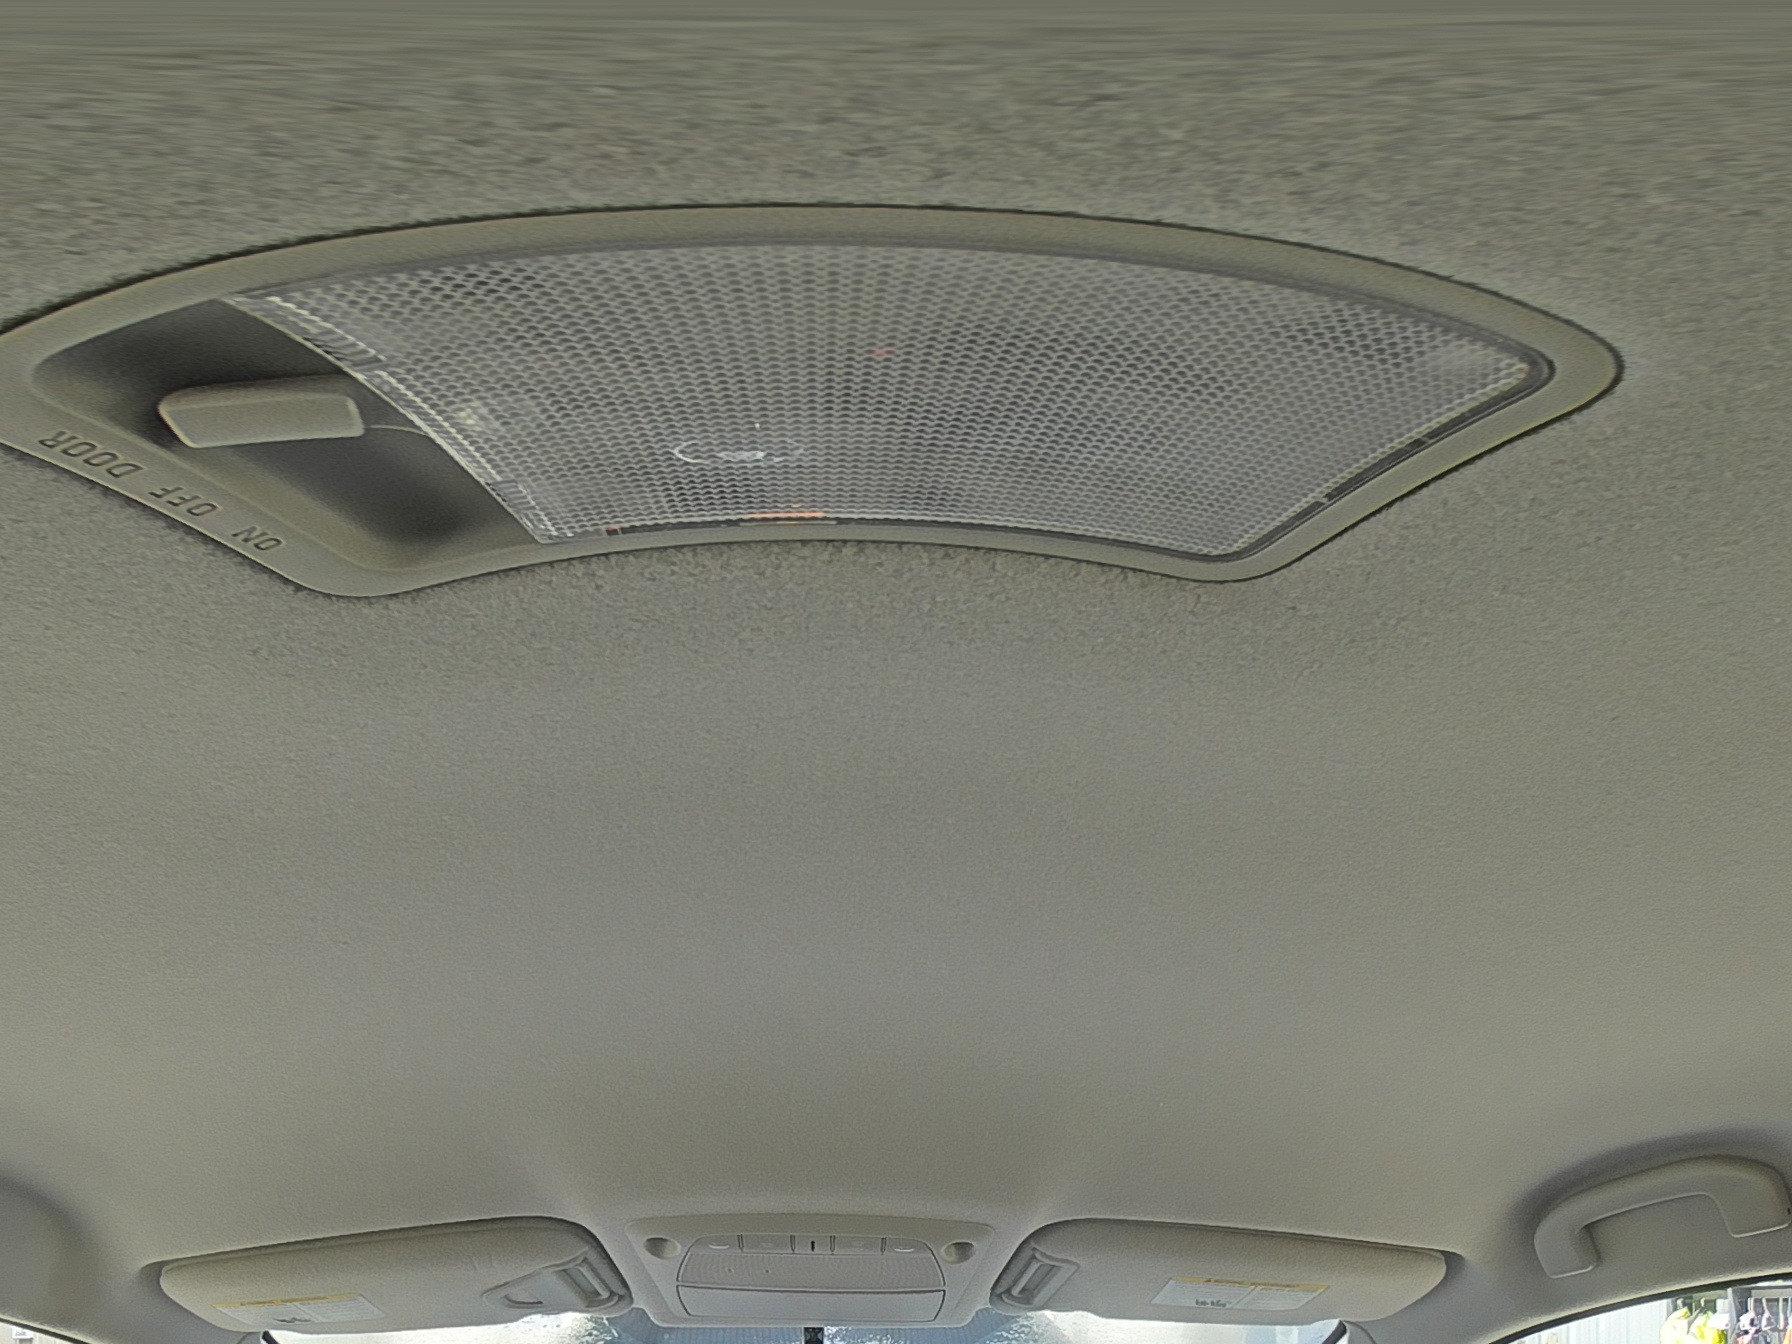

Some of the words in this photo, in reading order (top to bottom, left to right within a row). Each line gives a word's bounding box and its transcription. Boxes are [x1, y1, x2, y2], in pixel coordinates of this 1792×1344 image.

[38, 430, 144, 478] DOOR
[149, 486, 218, 517] OFF
[231, 526, 283, 551] ON
